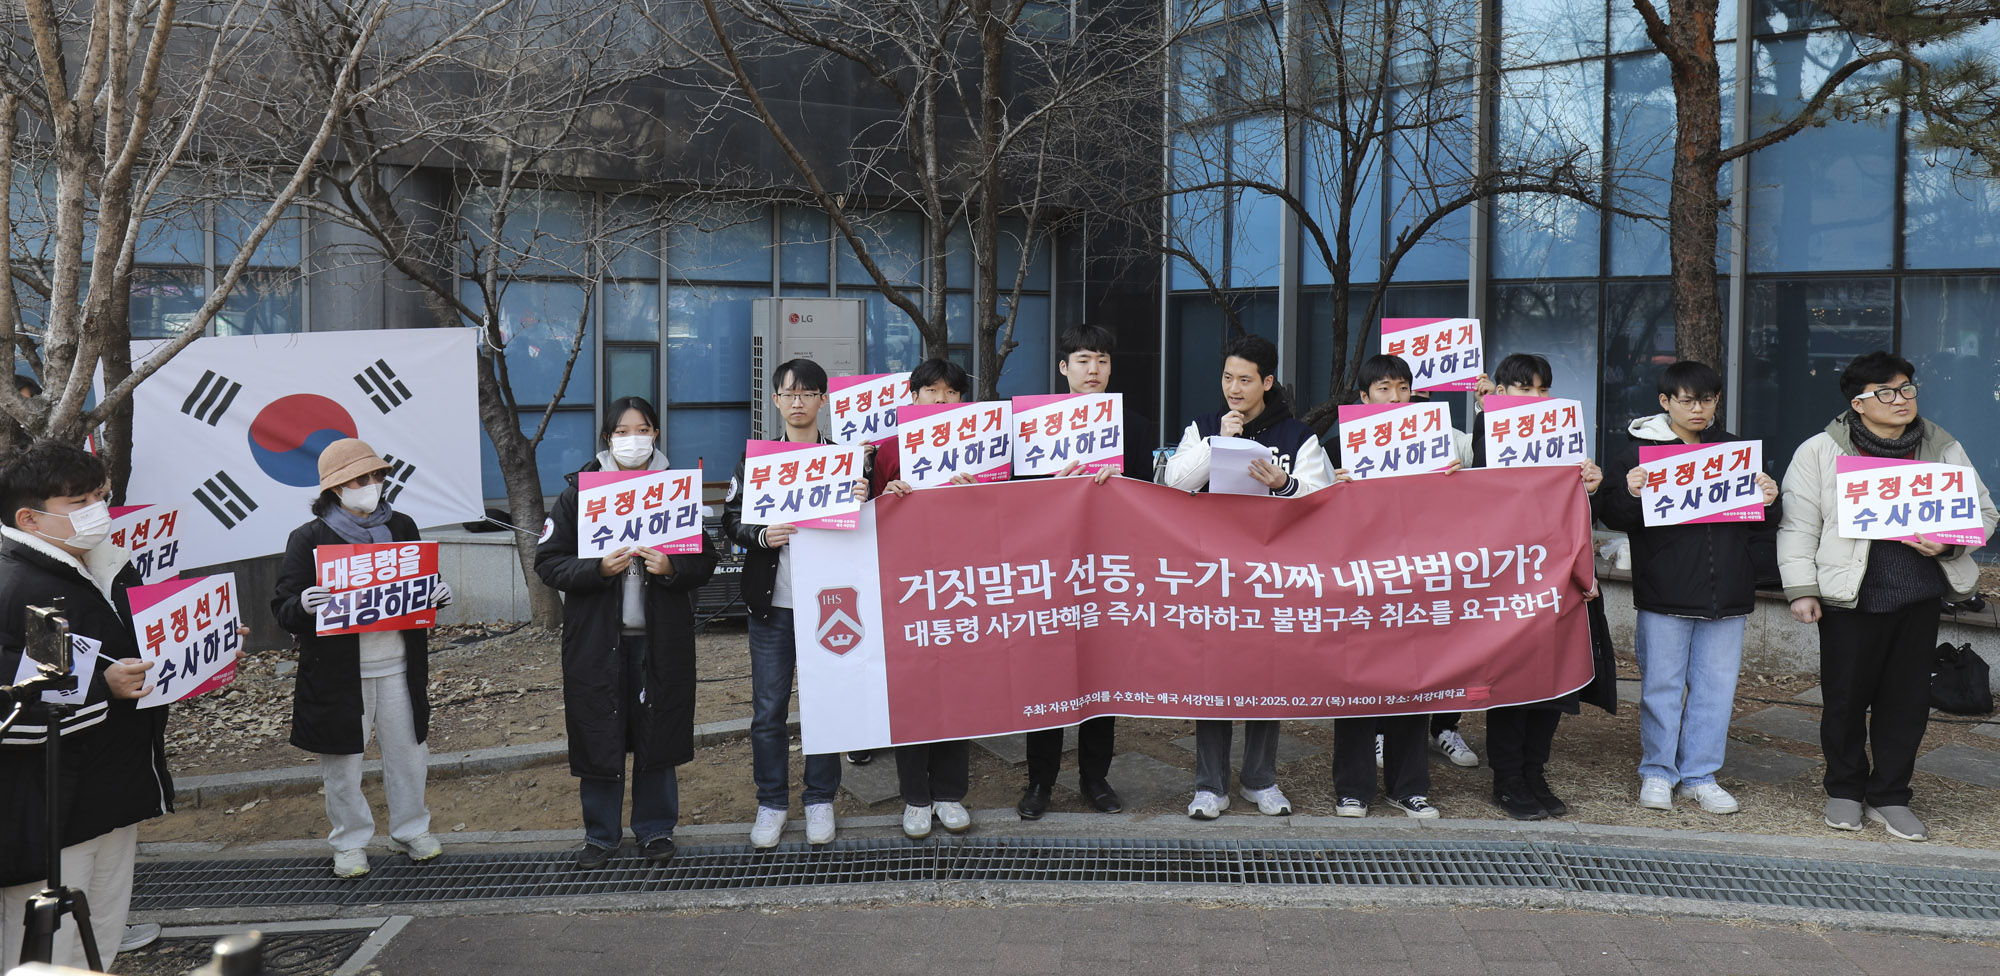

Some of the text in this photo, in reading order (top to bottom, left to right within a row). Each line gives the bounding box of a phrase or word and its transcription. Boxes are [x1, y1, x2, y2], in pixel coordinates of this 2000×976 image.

[801, 314, 814, 323] LG
[1387, 324, 1473, 357] 부정선거
[1414, 347, 1481, 379] 사하라
[840, 408, 897, 443] 수사하
[905, 407, 1002, 454] 부정선거
[1019, 399, 1113, 443] 부정선거
[1347, 408, 1441, 454] 부정선거
[1492, 405, 1576, 443] 부정선거
[911, 433, 1010, 481] 수사하라
[1025, 425, 1120, 469] 수사하라
[1353, 434, 1451, 478] 수사하라
[1498, 431, 1584, 467] 수사하라
[750, 452, 854, 490] 부정선거
[1646, 447, 1751, 493] 부정선거
[1844, 471, 1964, 505] 부정선거
[585, 476, 692, 523] 부정선거
[753, 480, 859, 518] 수사하라
[1654, 472, 1758, 519] 수사하라
[1851, 497, 1977, 532] 수사하라
[111, 509, 178, 552] 정선거
[590, 503, 699, 551] 수사하라
[136, 540, 179, 579] 하라
[322, 544, 421, 591] 대통령을
[898, 544, 1548, 611] 거짓말과 선동, 누가 진짜 내란범인가?
[145, 581, 231, 657] 부정선거
[320, 575, 436, 630] 석방하라
[822, 594, 842, 605] IHS
[903, 586, 1562, 648] 대통령 사기탄핵을 즉시 각하하고 불법구속 취소를 요구한다
[156, 616, 239, 696] 수사하라
[1022, 703, 1047, 718] 주최:
[1048, 690, 1112, 714] 자유민주주의를
[1112, 690, 1156, 704] 수호하는
[1156, 692, 1180, 705] 애국
[1180, 693, 1226, 707] 서강인들
[1233, 695, 1259, 707] 일시:
[1259, 696, 1290, 707] 2025.
[1291, 696, 1309, 707] 02.
[1310, 696, 1324, 706] 27
[1325, 695, 1346, 708] (목)
[1347, 696, 1376, 706] 14:00
[1384, 694, 1410, 705] 장소:
[1411, 688, 1467, 703] 서강대학교
